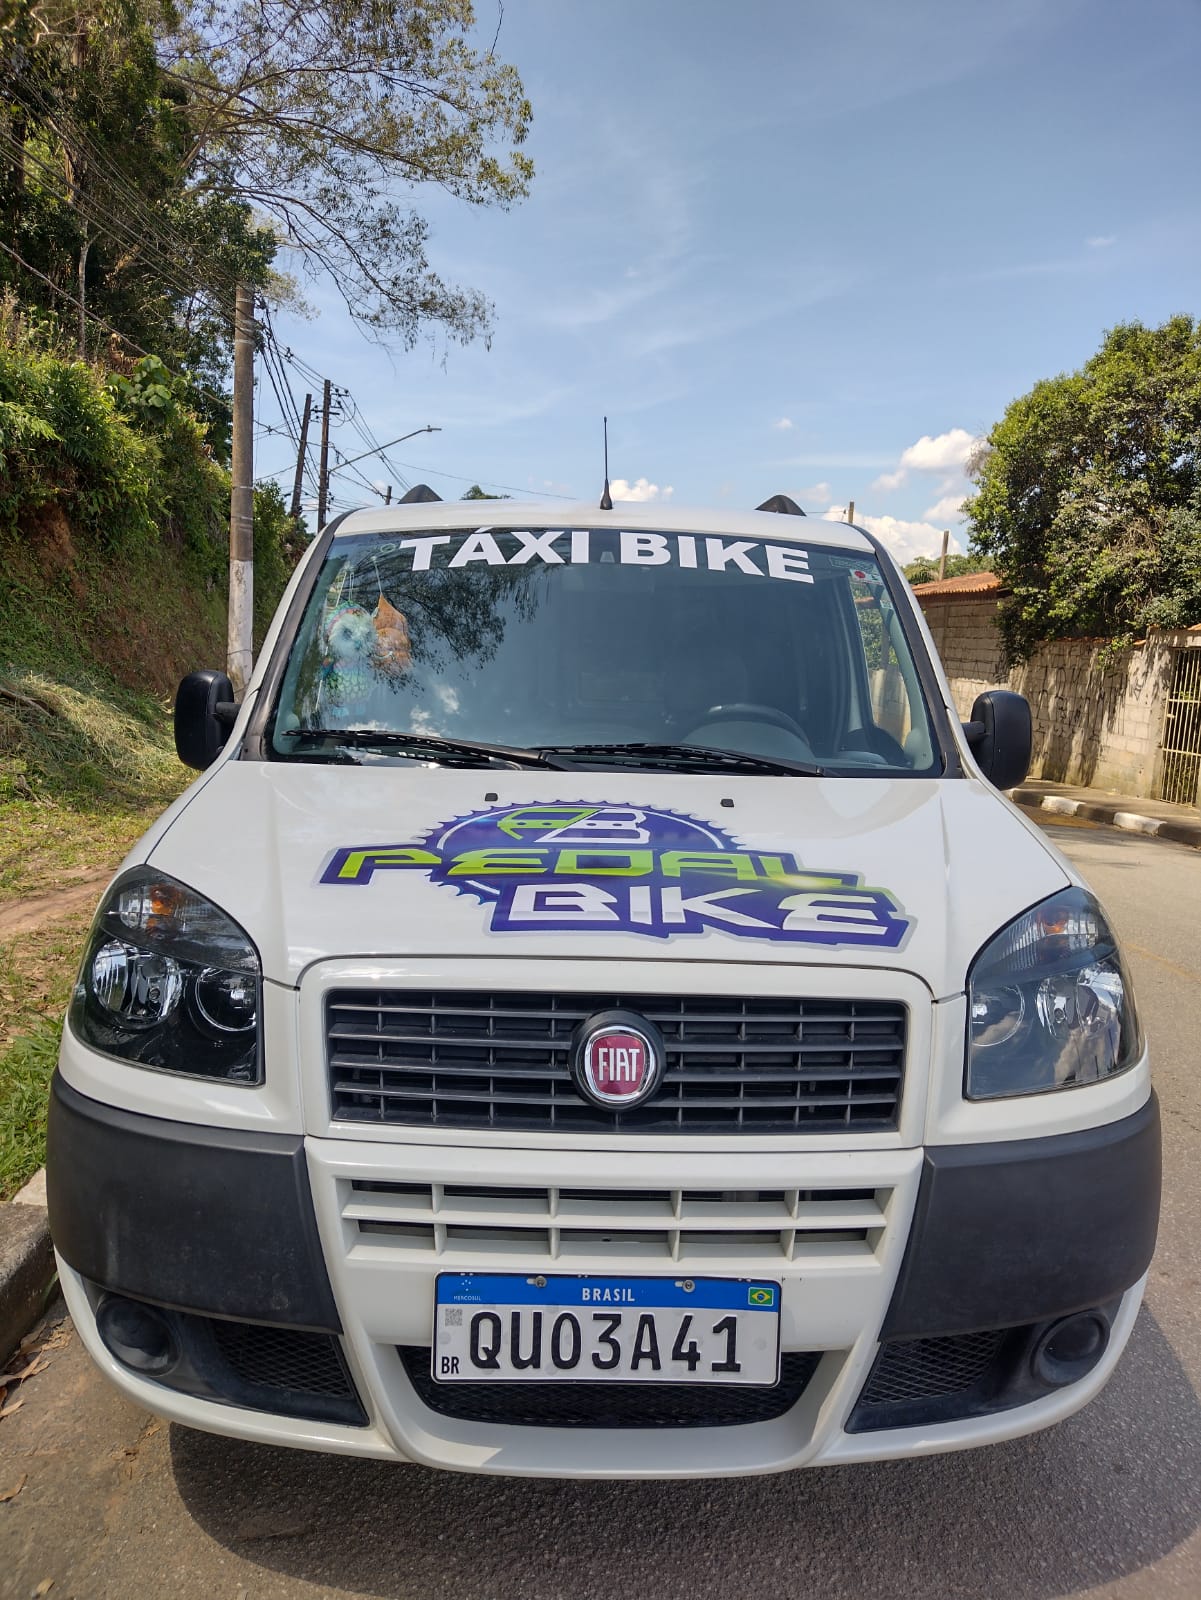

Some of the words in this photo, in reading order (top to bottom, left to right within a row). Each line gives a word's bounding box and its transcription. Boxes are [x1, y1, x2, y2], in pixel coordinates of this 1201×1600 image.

[400, 528, 590, 571] TÁXI
[620, 533, 815, 584] BIKE
[338, 849, 843, 886] PEDAL
[508, 884, 890, 935] BIKE
[598, 1048, 640, 1081] FIAT
[582, 1287, 635, 1302] BRASIL
[441, 1356, 459, 1375] BR
